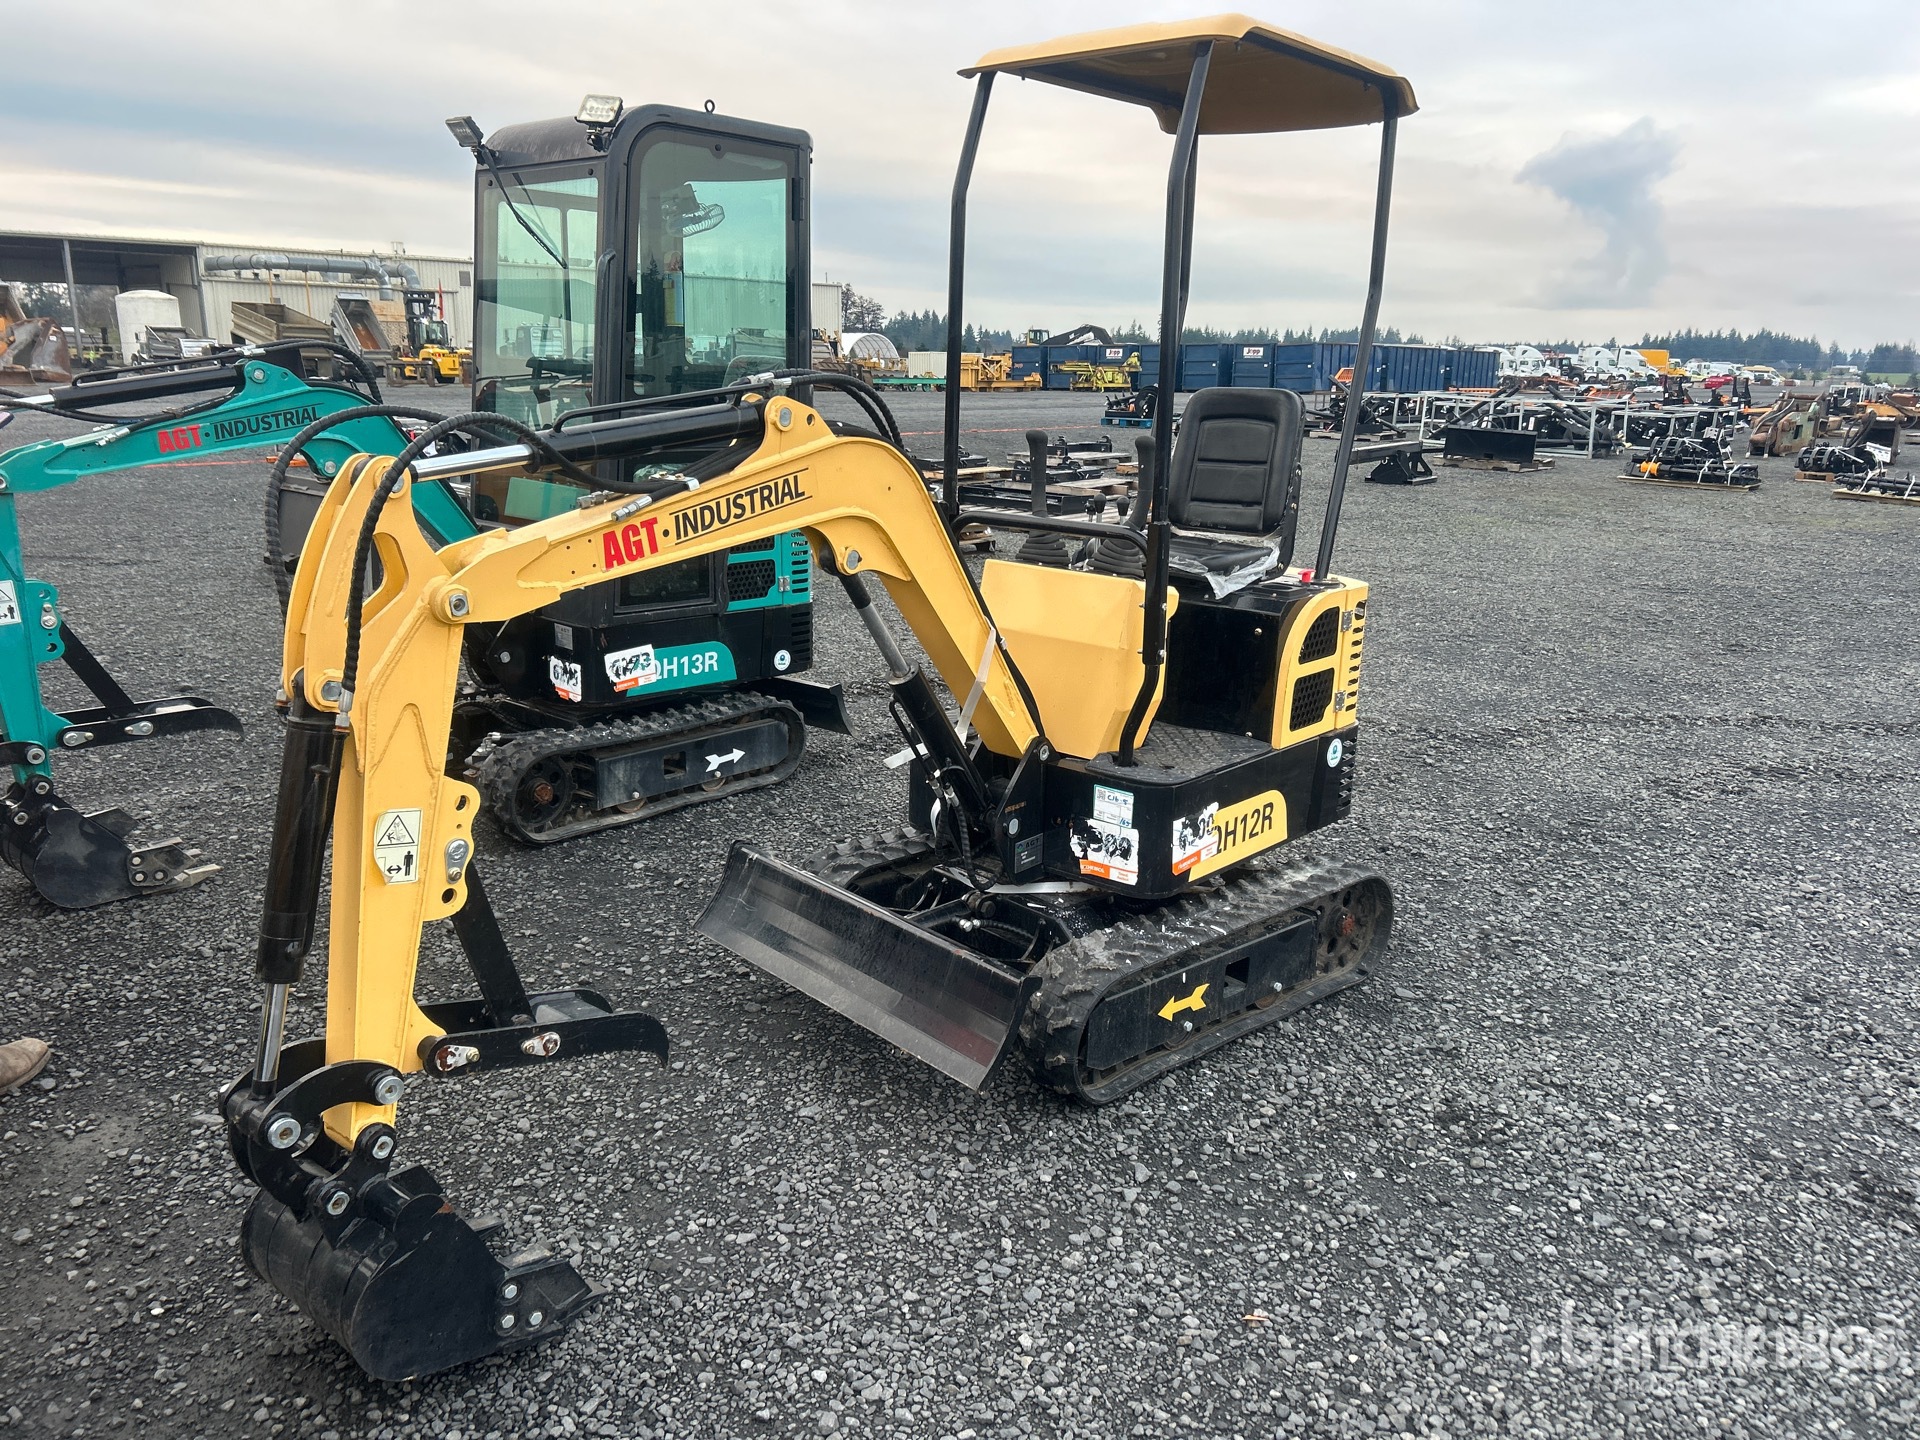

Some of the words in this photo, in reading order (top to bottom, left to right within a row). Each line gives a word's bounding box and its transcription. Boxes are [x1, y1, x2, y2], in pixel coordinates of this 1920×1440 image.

[157, 424, 202, 454] AGT
[213, 406, 321, 441] INDUSTRIAL
[602, 517, 659, 570] AGT
[673, 474, 806, 542] INDUSTRIAL
[1025, 838, 1040, 849] AGT
